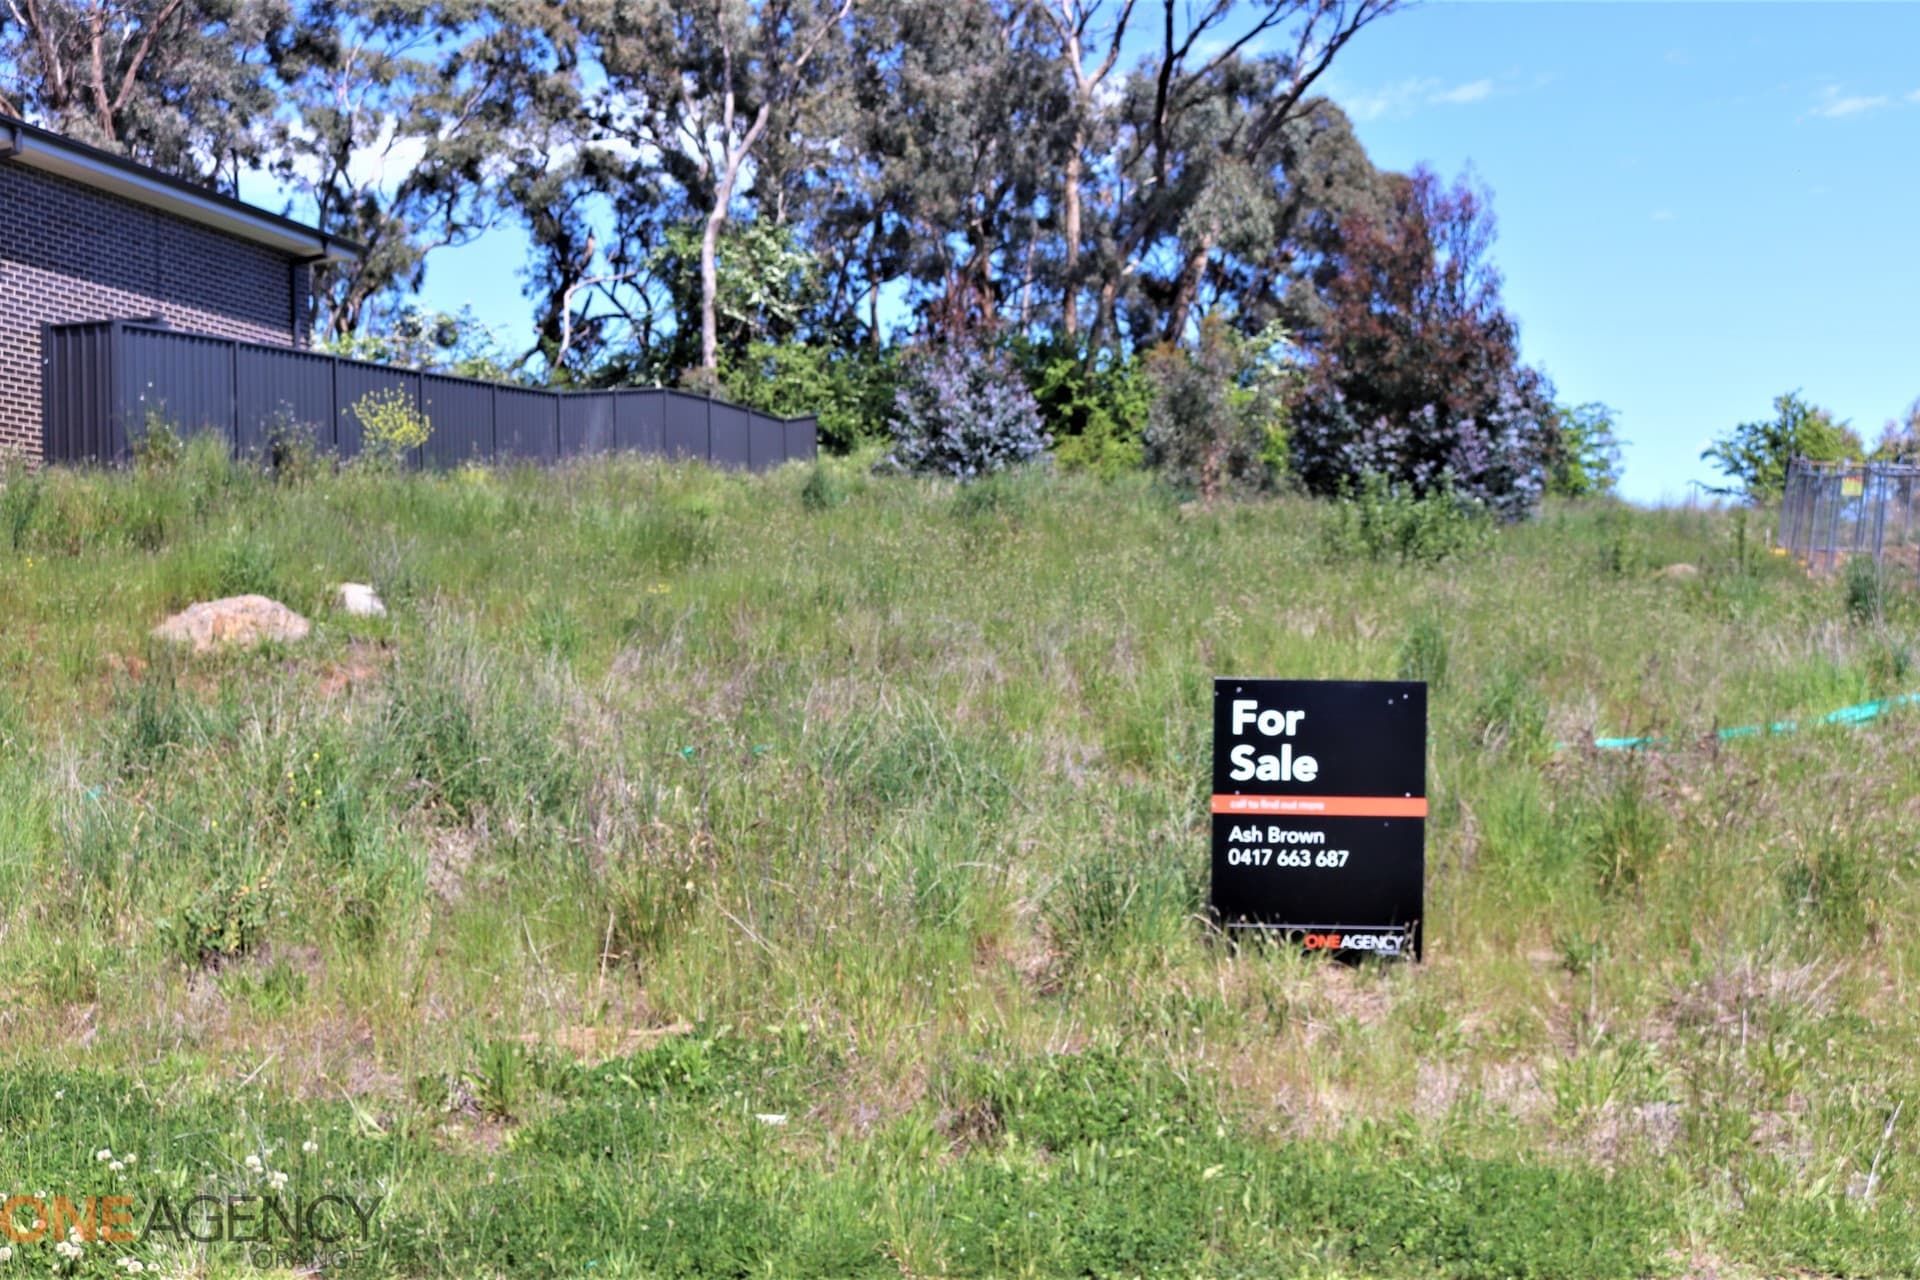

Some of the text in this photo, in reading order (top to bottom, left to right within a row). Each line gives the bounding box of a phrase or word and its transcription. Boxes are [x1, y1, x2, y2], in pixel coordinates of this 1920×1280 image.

[1232, 699, 1305, 736] For
[1229, 744, 1318, 782] Sale
[1229, 799, 1247, 809] call
[1247, 800, 1259, 809] to
[1260, 798, 1280, 810] find
[1228, 825, 1325, 844] Ash Brown
[1228, 848, 1349, 867] 0417 663 687
